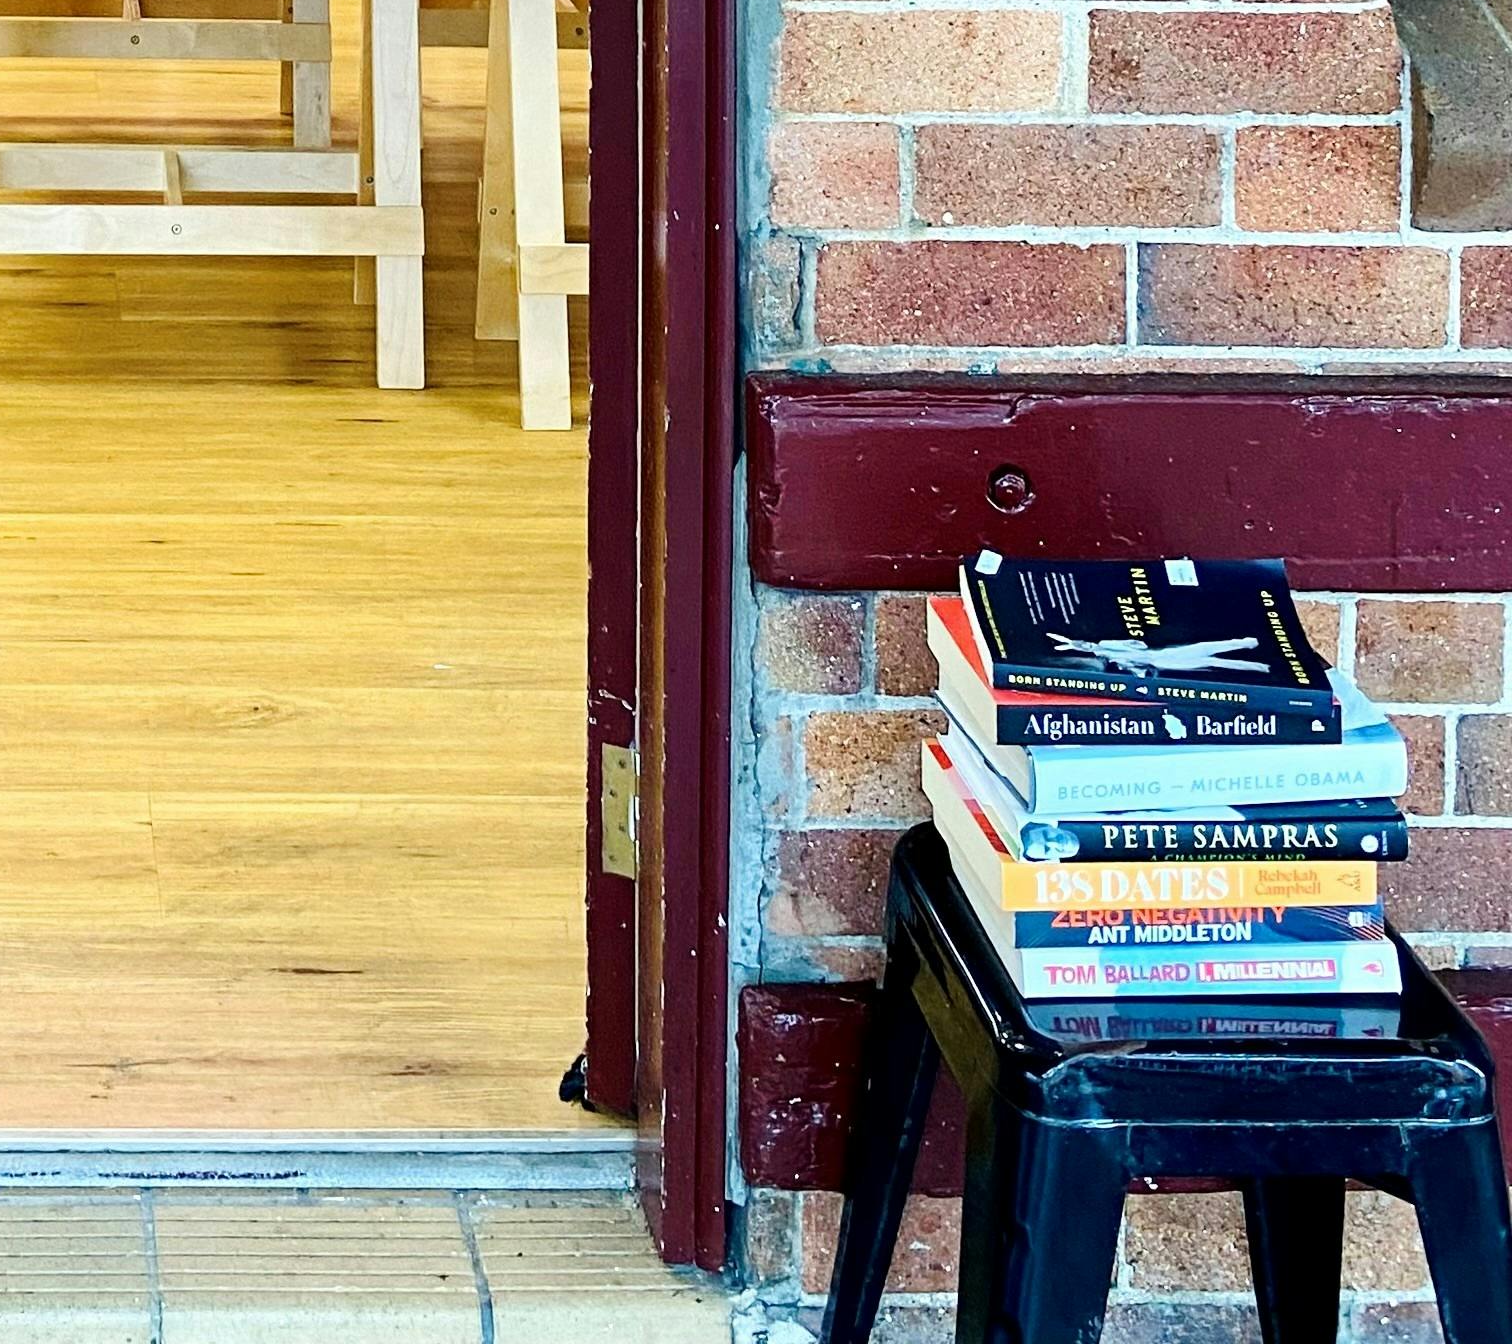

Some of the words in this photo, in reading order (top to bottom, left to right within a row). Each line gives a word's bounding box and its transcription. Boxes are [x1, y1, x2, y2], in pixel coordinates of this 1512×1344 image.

[1129, 567, 1162, 626] MARTIN
[1260, 589, 1276, 610] UP
[1116, 595, 1145, 637] STEVE
[1265, 610, 1298, 663] STANDING
[1286, 660, 1311, 686] BORN
[1008, 673, 1042, 686] BORN
[1045, 676, 1107, 691] STANDING
[1109, 682, 1128, 693] UP
[1157, 686, 1197, 699] STEVE
[1200, 691, 1249, 704] MARTIN
[1023, 713, 1156, 742] Afghanistan
[1196, 714, 1278, 737] Barfield
[1057, 780, 1162, 801] BECOMING
[1190, 774, 1286, 793] MICHELLE
[1294, 770, 1365, 788] OBAMA
[1101, 823, 1179, 850] PETE
[1192, 823, 1339, 849] SAMPRAS
[1034, 868, 1095, 905] 138
[1100, 867, 1230, 904] DATES
[1257, 868, 1318, 883] Rebekah
[1254, 882, 1321, 898] Campbell
[1088, 926, 1130, 945] ANT
[1134, 922, 1252, 944] MIDDLETON
[1043, 965, 1097, 986] TOM
[1104, 963, 1190, 985] BALLARD
